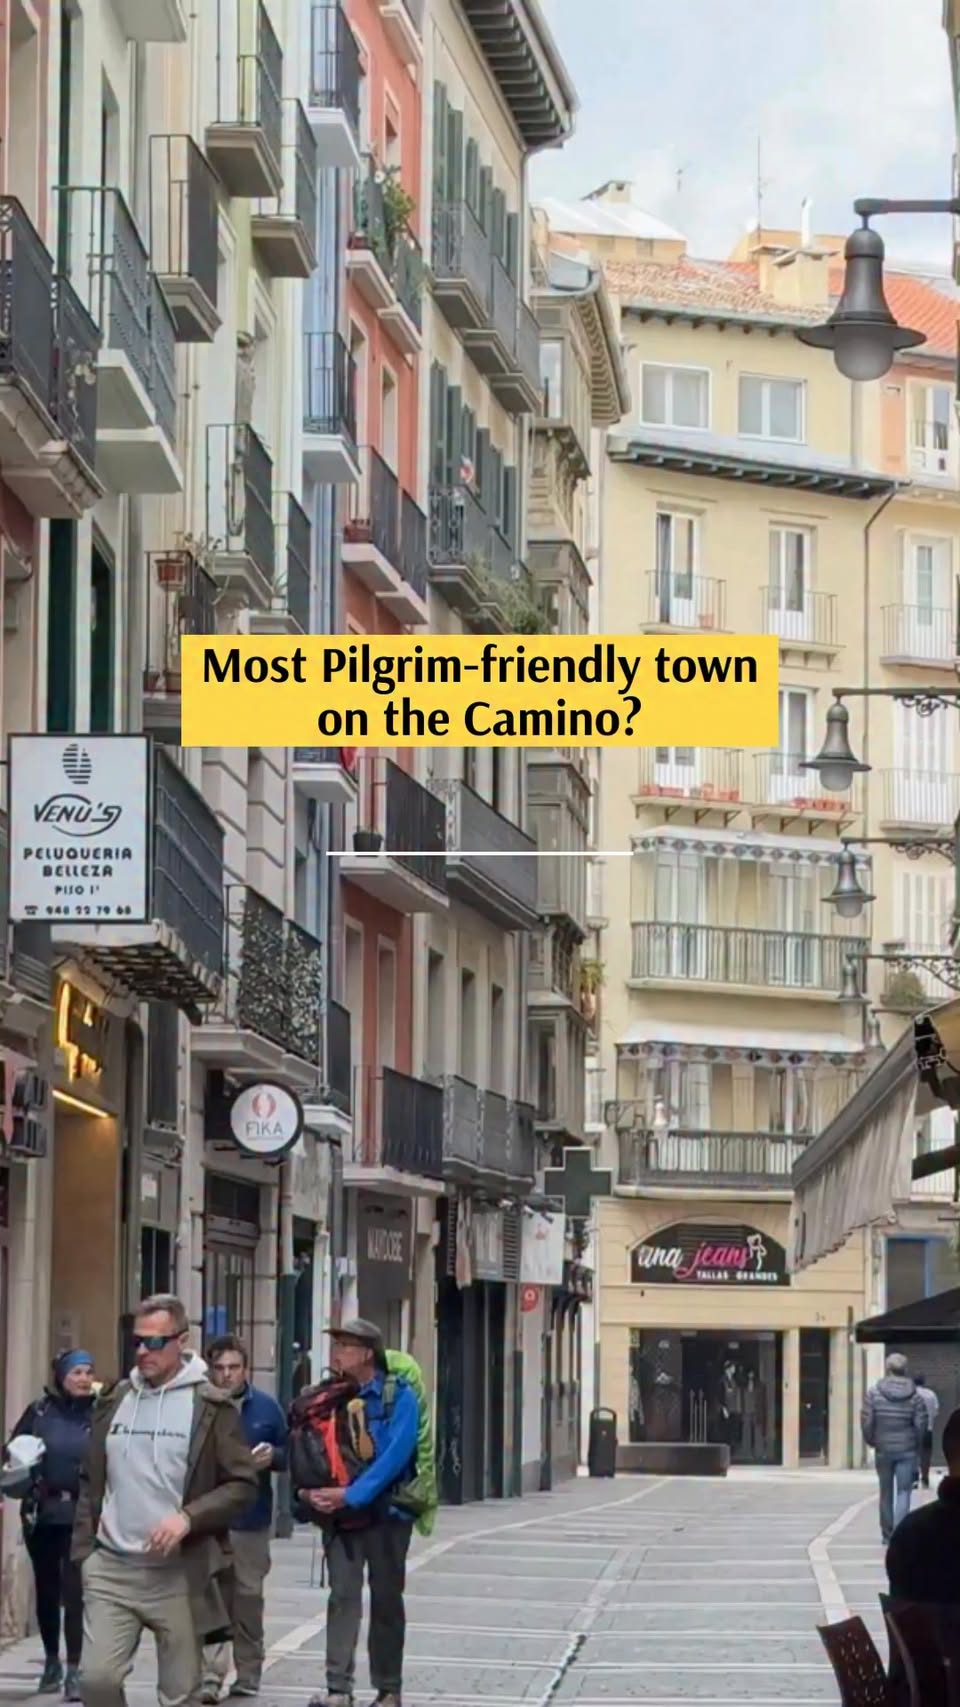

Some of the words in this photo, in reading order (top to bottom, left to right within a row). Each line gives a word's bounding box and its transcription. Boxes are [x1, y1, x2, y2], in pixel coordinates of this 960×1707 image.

[23, 847, 132, 860] PELUQUERIA
[43, 865, 113, 877] BELLEZA
[55, 885, 85, 895] PISO
[246, 1121, 283, 1136] FIKA
[697, 1270, 729, 1281] TALLAS
[736, 1271, 778, 1281] GRANDES
